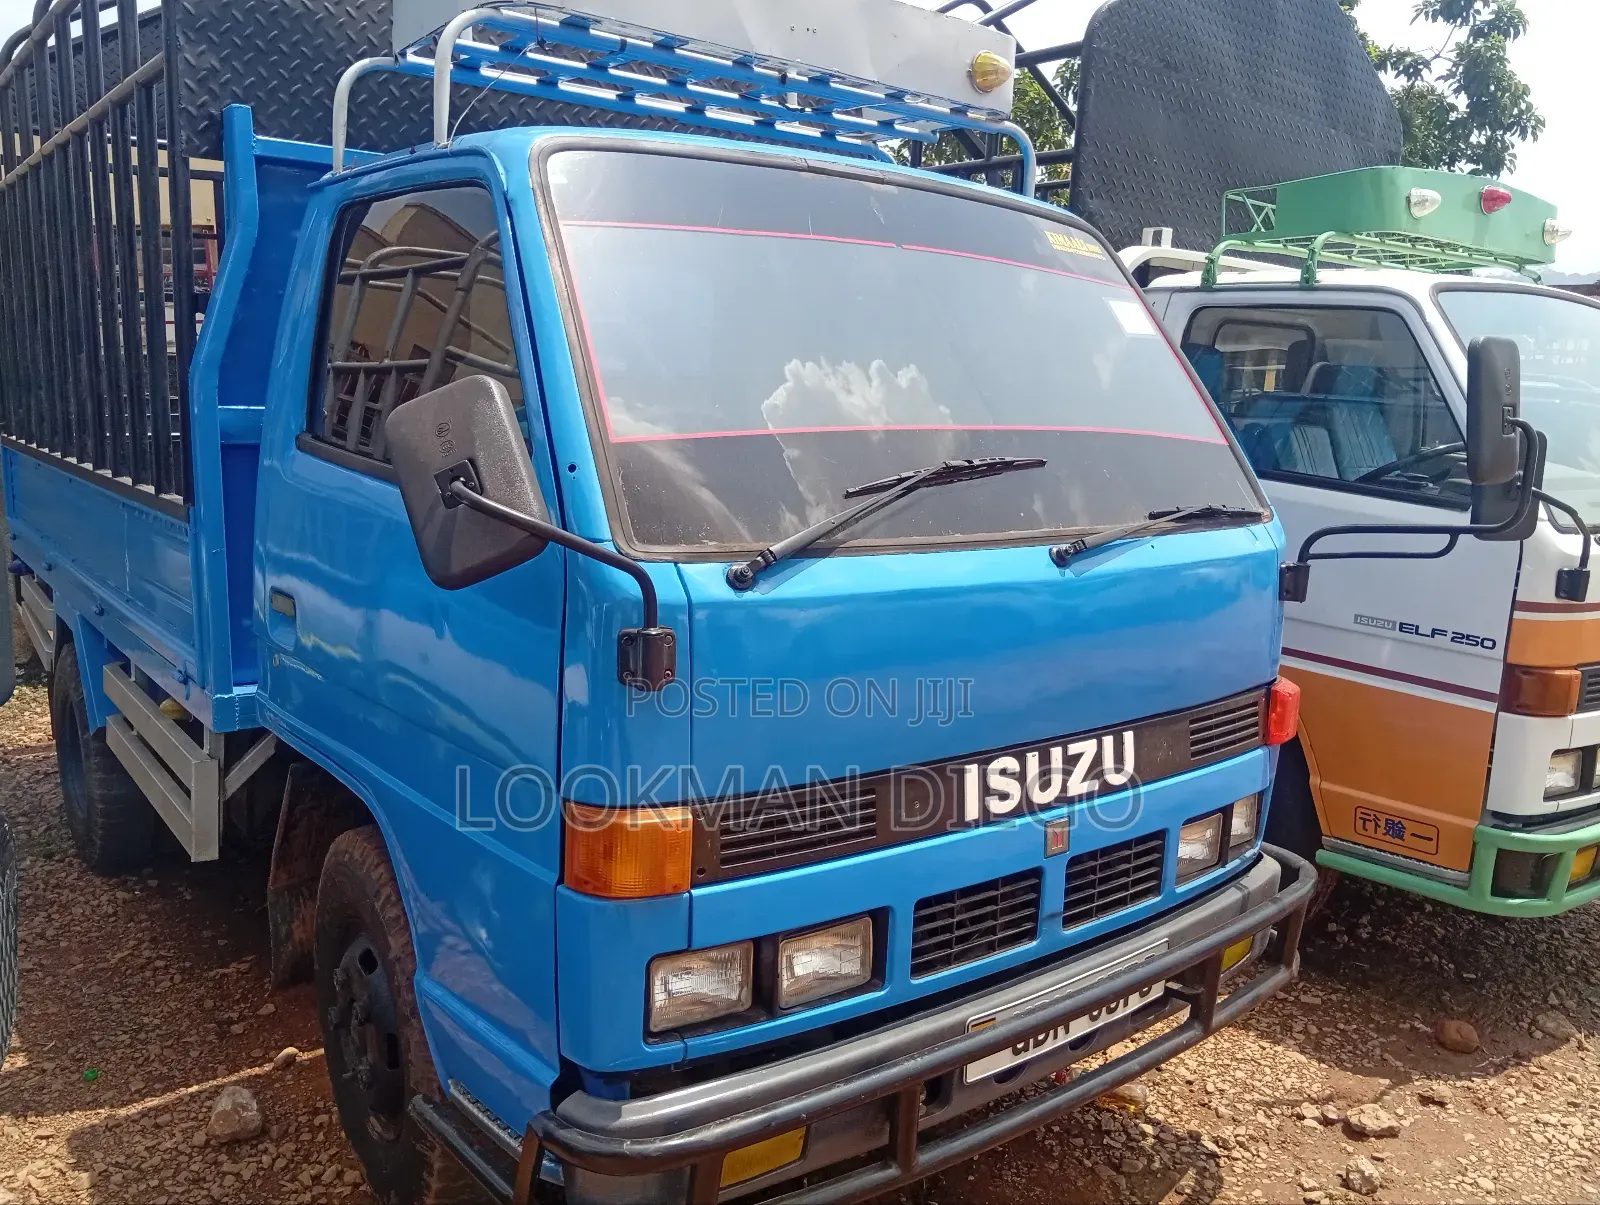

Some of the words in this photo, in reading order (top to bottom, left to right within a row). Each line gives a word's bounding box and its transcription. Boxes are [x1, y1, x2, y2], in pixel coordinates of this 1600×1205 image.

[1356, 615, 1393, 629] ISUZU
[1398, 621, 1448, 639] ELF
[1450, 631, 1497, 651] 250
[964, 730, 1135, 822] ISUZU
